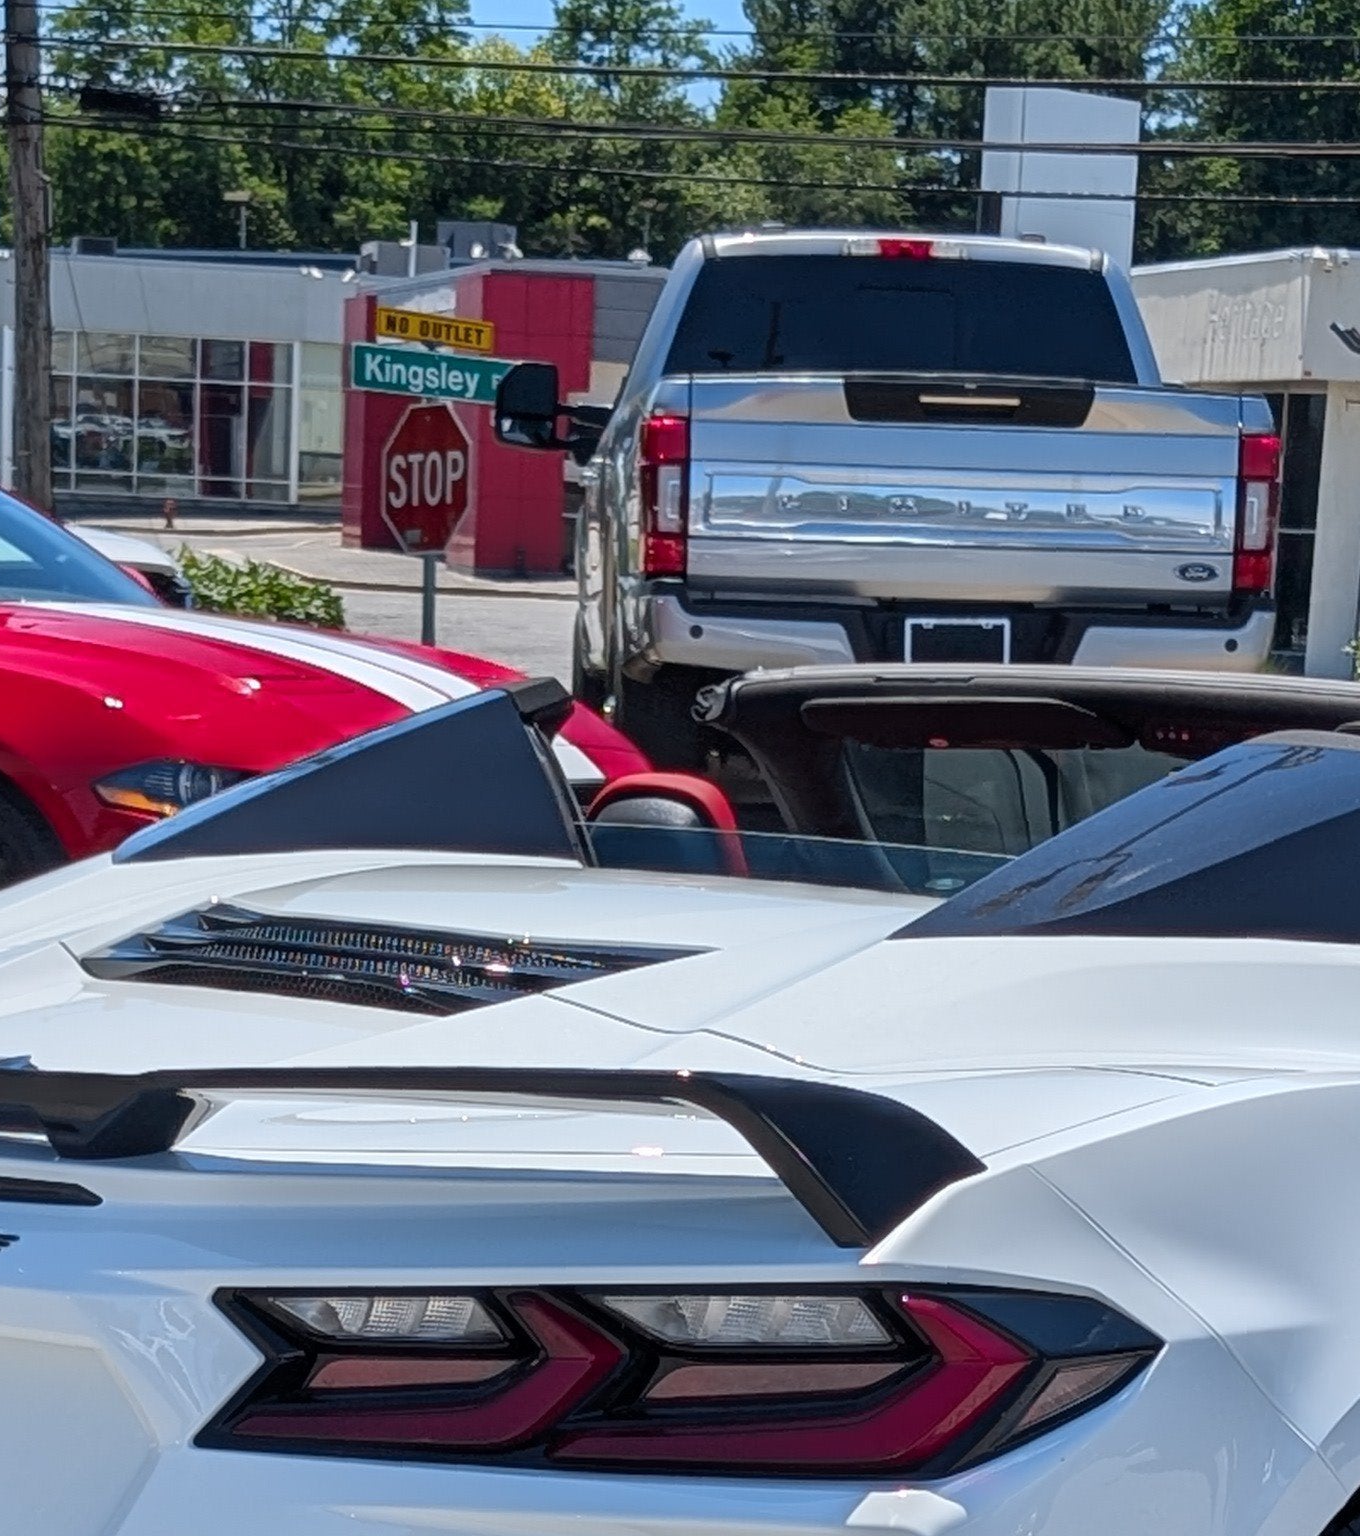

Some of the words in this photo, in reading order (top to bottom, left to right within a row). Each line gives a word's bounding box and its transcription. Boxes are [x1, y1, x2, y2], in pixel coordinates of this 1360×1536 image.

[386, 316, 409, 334] NO
[419, 320, 485, 346] OUTLET
[364, 353, 480, 399] Kingsley
[388, 450, 465, 509] STOP
